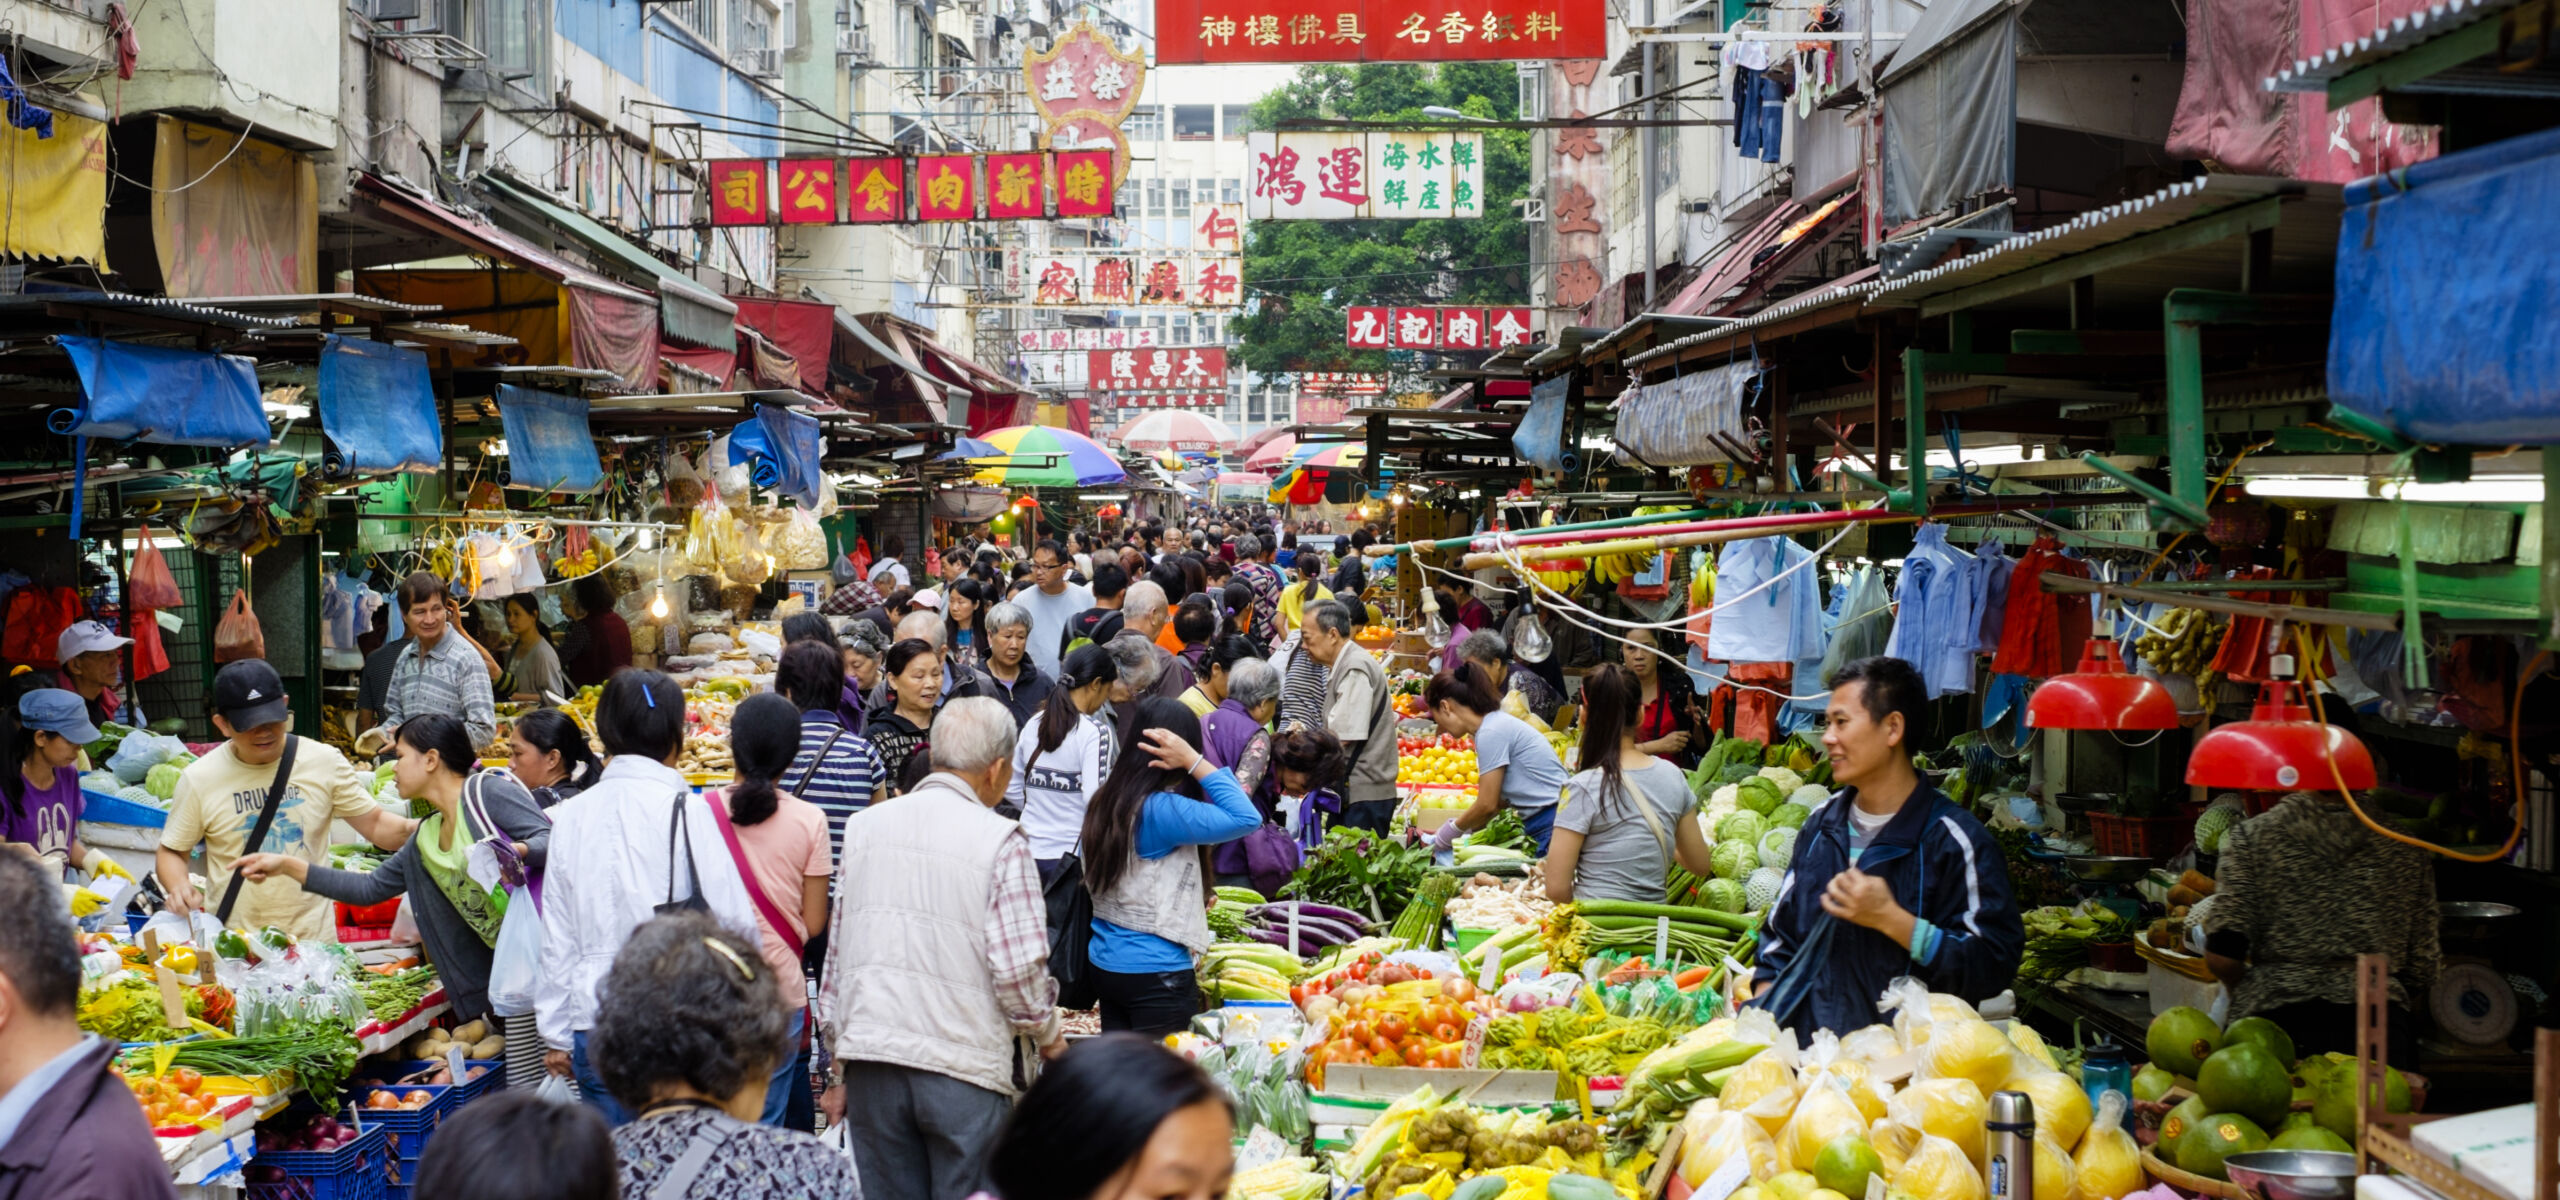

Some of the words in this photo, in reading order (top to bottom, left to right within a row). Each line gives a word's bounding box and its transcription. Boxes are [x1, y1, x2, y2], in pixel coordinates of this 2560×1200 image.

[1199, 13, 1367, 48] 神樓佛具
[1396, 11, 1563, 44] 名香紙料
[1255, 146, 1371, 206] 鴻運
[1350, 310, 1528, 347] 九記肉食
